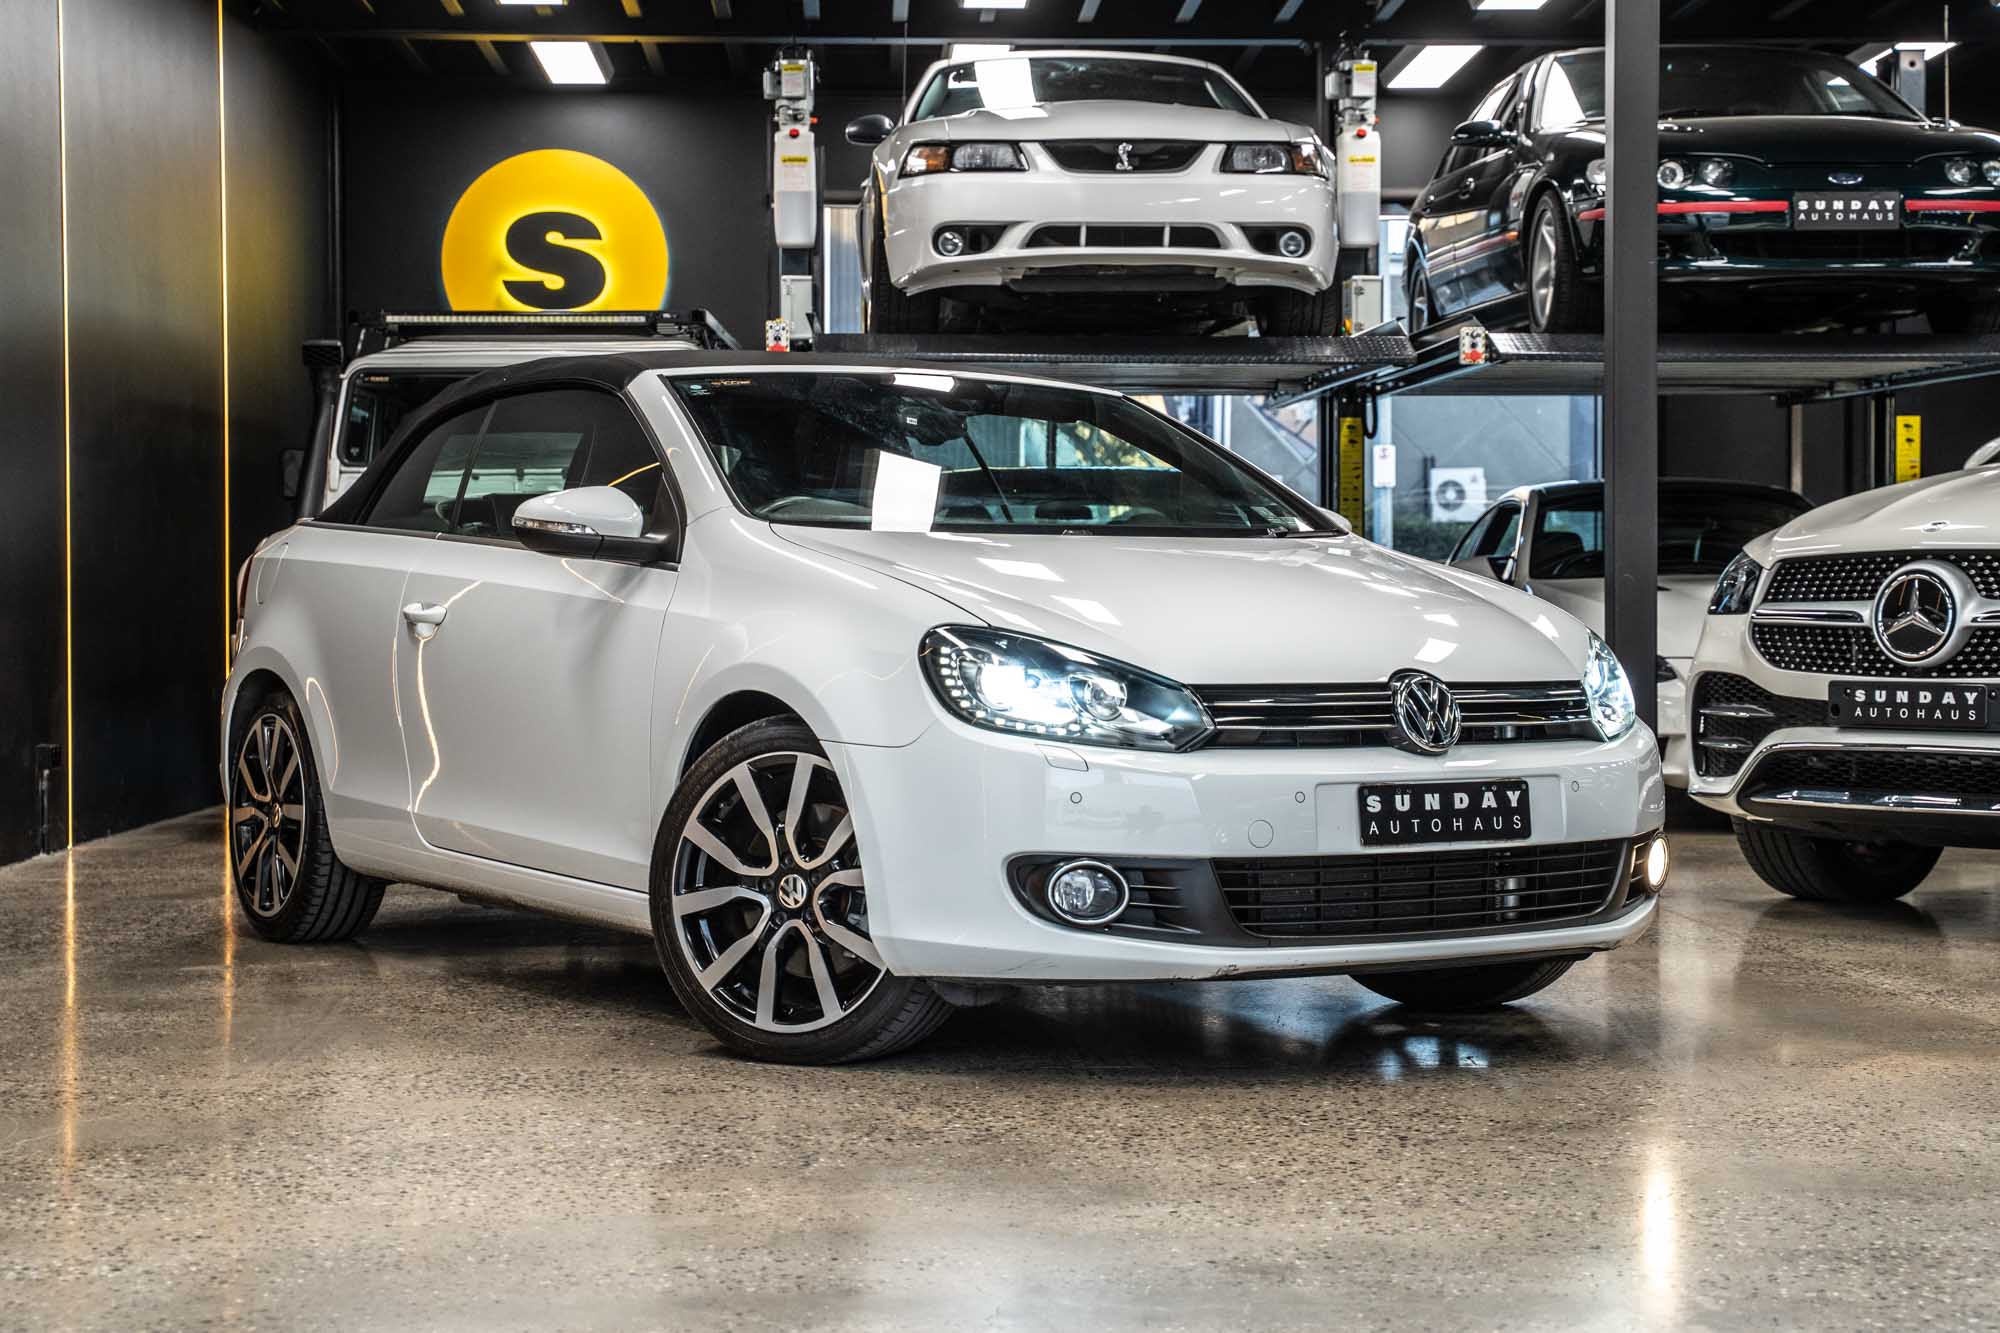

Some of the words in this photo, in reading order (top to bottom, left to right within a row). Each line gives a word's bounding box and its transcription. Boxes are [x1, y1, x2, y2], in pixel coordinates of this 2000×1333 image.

[1798, 199, 1896, 211] SUNDAY
[1798, 212, 1895, 221] AUTOHAUS
[502, 211, 606, 310] S
[1854, 689, 1978, 705] SUNDAY
[1401, 676, 1460, 750] VW
[1855, 707, 1977, 721] AUTOHAUS
[1366, 790, 1522, 813] SUNDAY
[1369, 815, 1521, 835] AUTOHAUS
